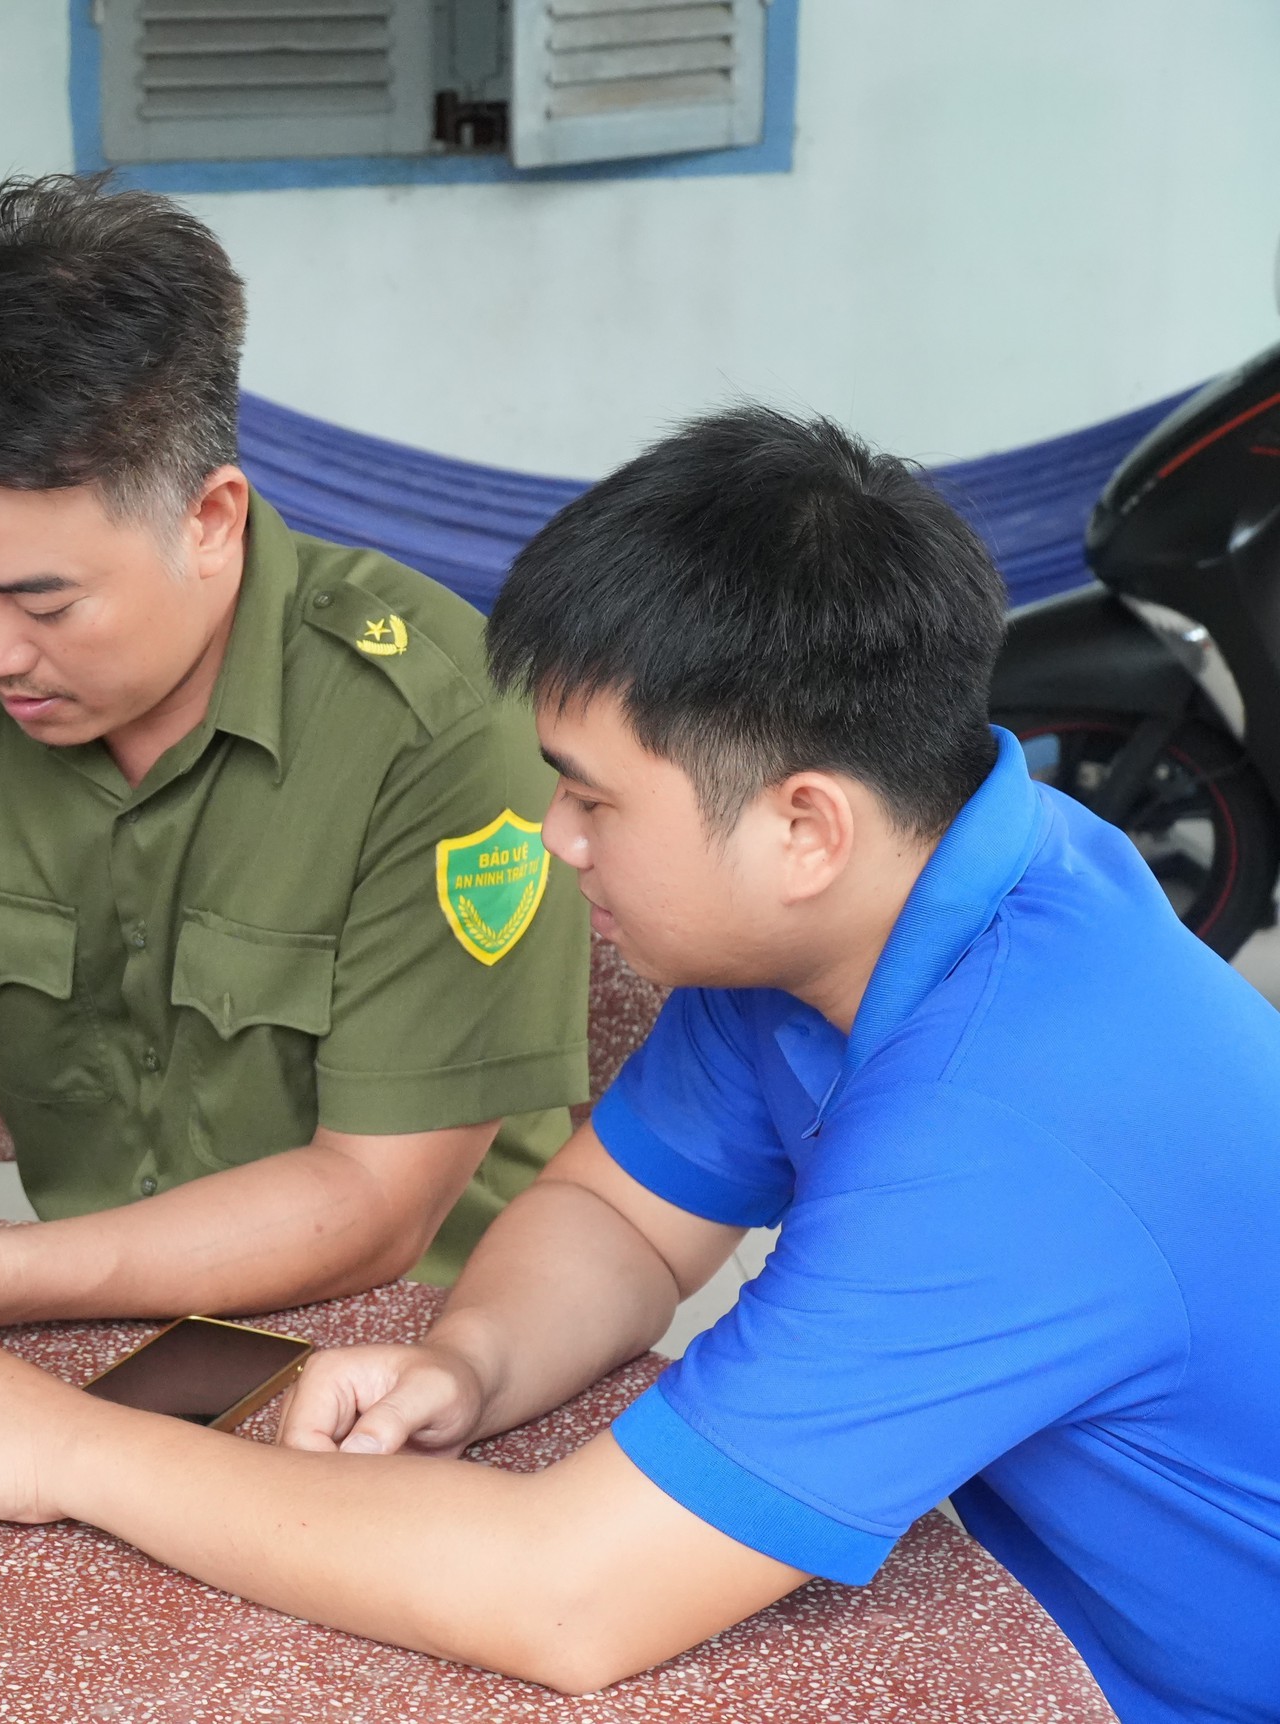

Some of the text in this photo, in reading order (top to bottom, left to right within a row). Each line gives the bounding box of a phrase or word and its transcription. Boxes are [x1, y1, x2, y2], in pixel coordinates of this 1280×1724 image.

[479, 846, 509, 868] BẢO
[455, 874, 473, 889] AN
[476, 870, 504, 887] NINH
